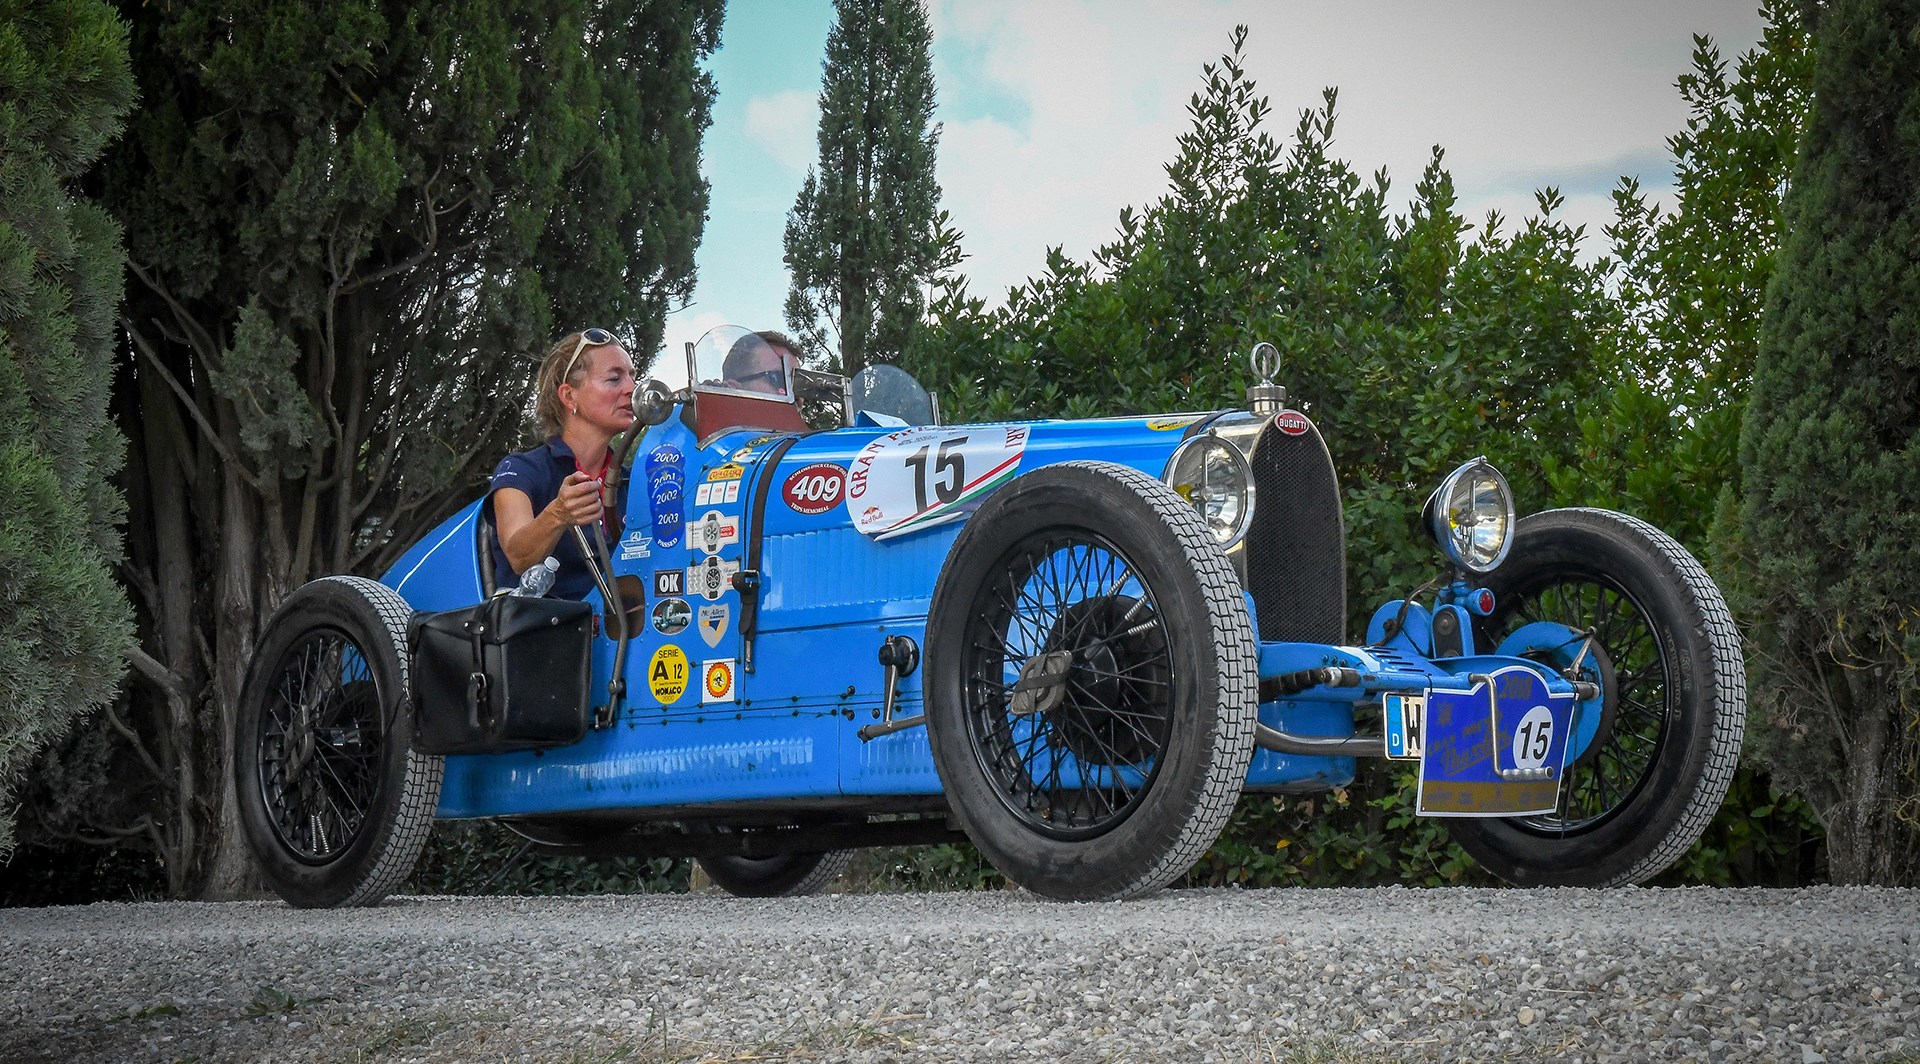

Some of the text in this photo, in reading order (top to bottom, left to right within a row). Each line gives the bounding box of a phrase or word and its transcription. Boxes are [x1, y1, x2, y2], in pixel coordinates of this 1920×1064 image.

[1279, 418, 1307, 430] BUGATTI
[654, 452, 679, 463] 2000
[850, 442, 885, 499] GRAN
[904, 436, 969, 513] 15
[654, 473, 676, 489] 2001
[791, 475, 841, 502] 409
[656, 490, 678, 505] 2002
[658, 513, 679, 525] 2003
[861, 511, 884, 525] Red Bull
[657, 537, 678, 549] PASSED
[659, 574, 679, 593] OK
[658, 649, 679, 659] SERIE
[652, 660, 683, 681] A 12
[655, 686, 682, 696] MONACO
[1392, 733, 1400, 747] D
[1404, 703, 1421, 750] W
[1520, 721, 1551, 760] 15
